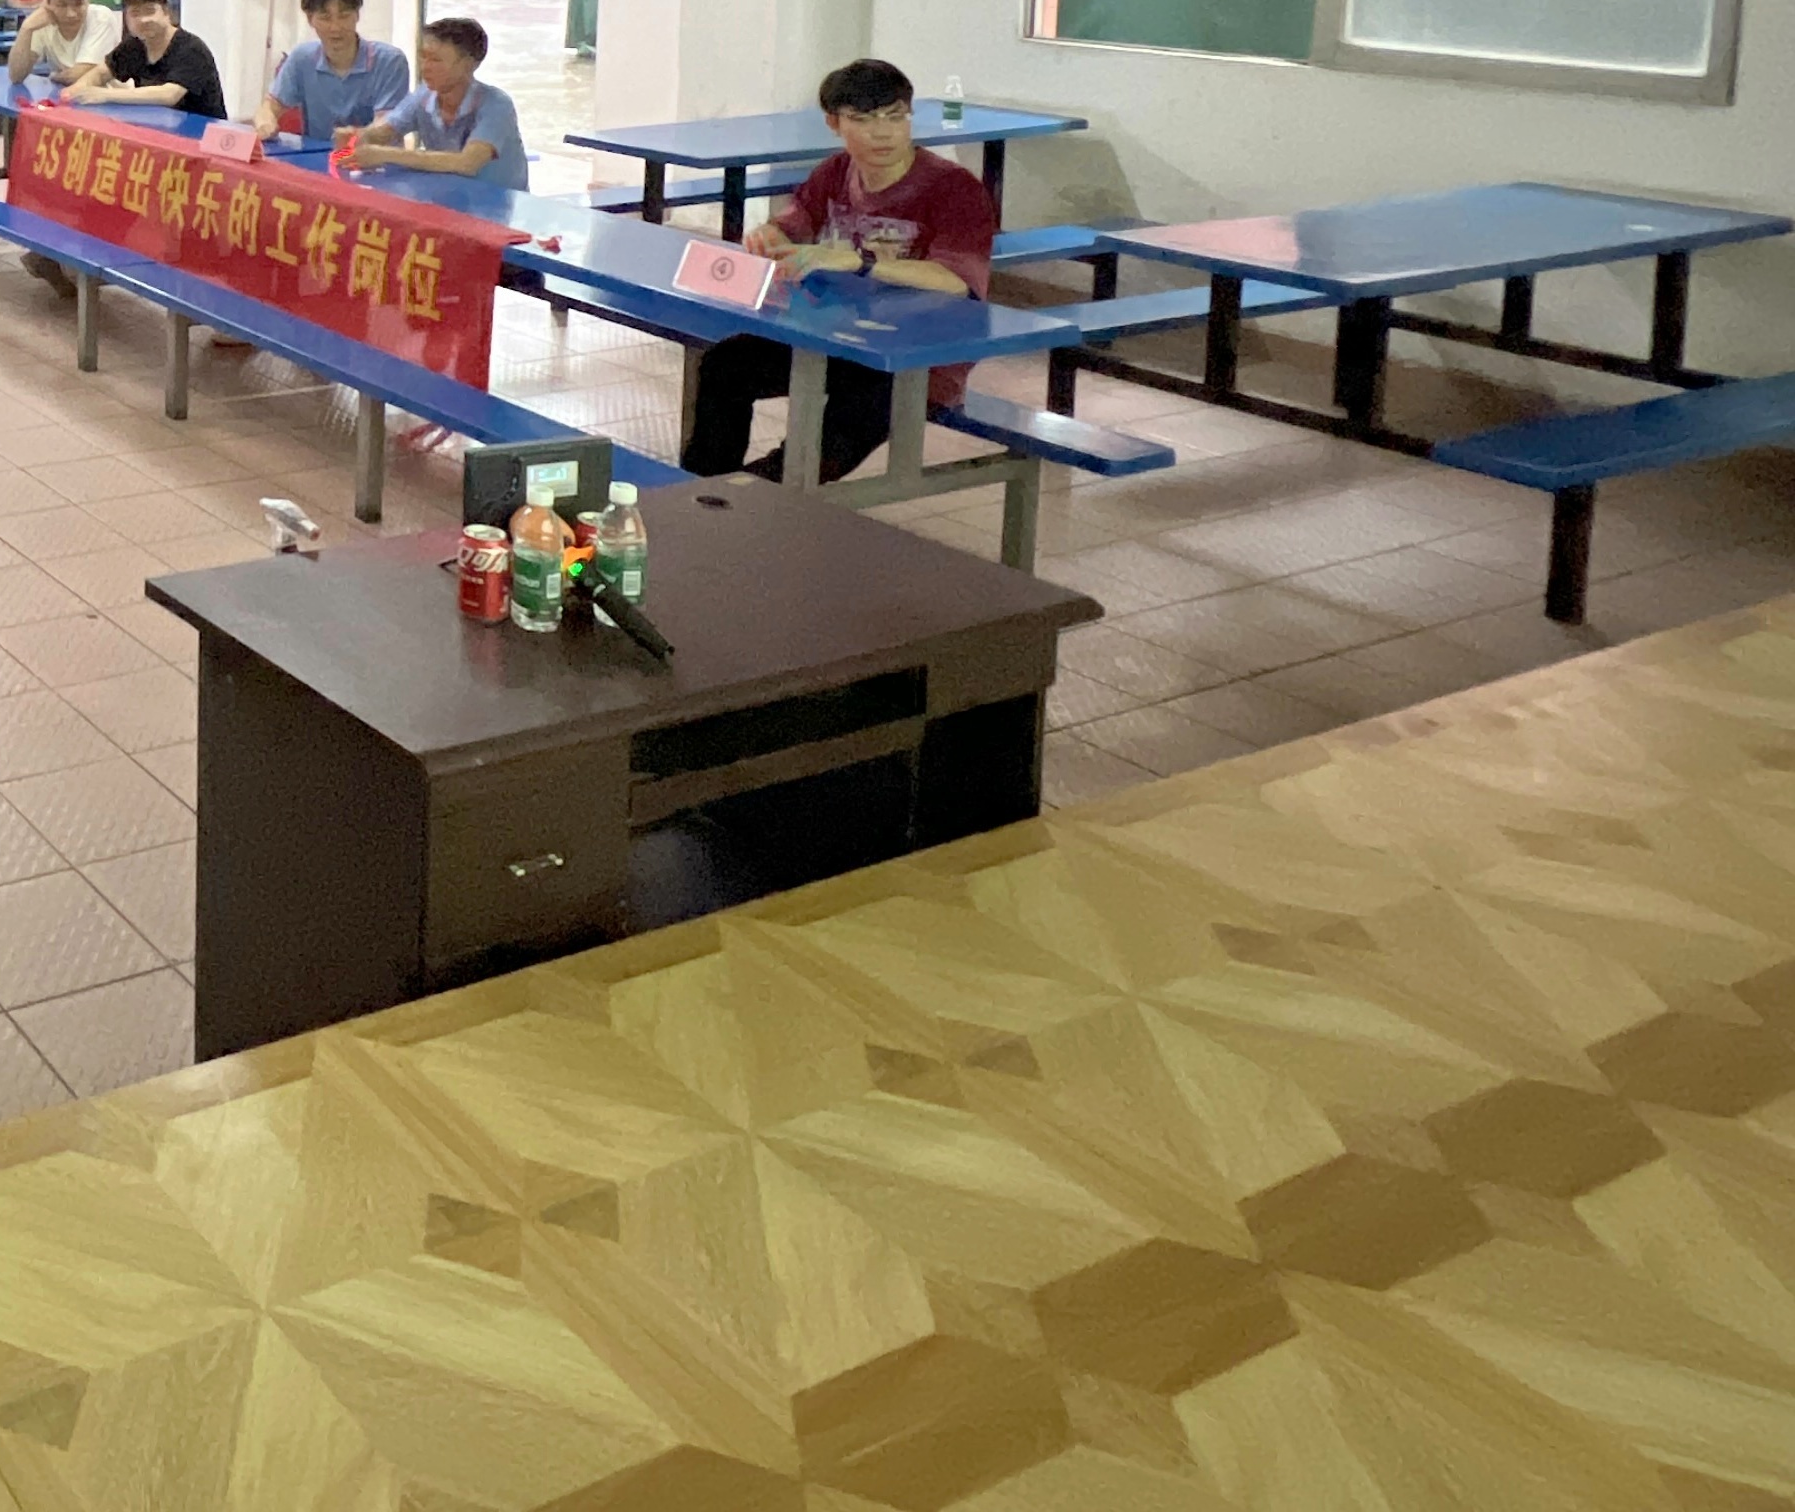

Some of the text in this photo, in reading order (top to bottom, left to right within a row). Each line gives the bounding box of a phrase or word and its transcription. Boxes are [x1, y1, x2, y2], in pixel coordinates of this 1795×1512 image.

[31, 126, 443, 322] 5S创造出快乐的工作岗位
